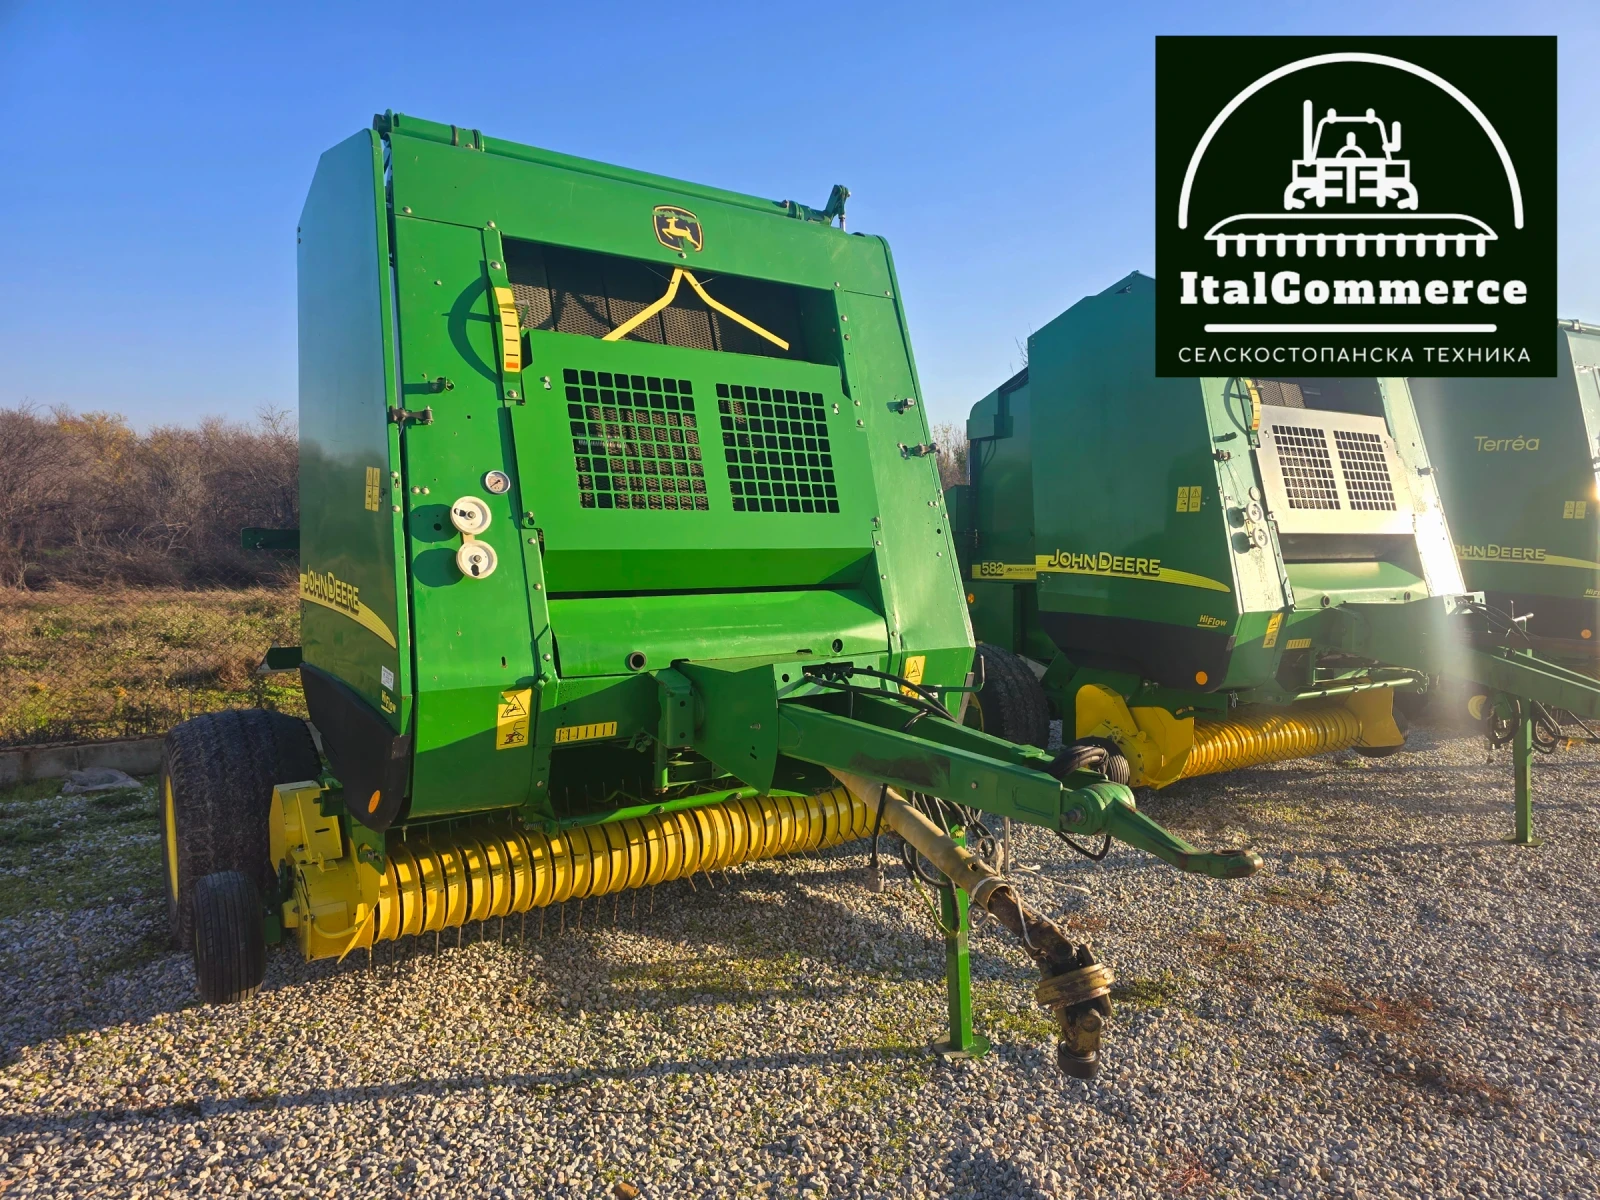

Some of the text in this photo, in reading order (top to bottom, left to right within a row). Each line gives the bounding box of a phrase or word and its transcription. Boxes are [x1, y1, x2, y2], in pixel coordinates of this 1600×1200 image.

[1473, 434, 1540, 452] Terréa
[1454, 544, 1546, 560] OHN DEERE
[980, 561, 1004, 576] 582
[1048, 548, 1161, 575] JOHN DEERE
[304, 564, 359, 614] JOHN DEERE
[1199, 614, 1228, 627] HiFlow
